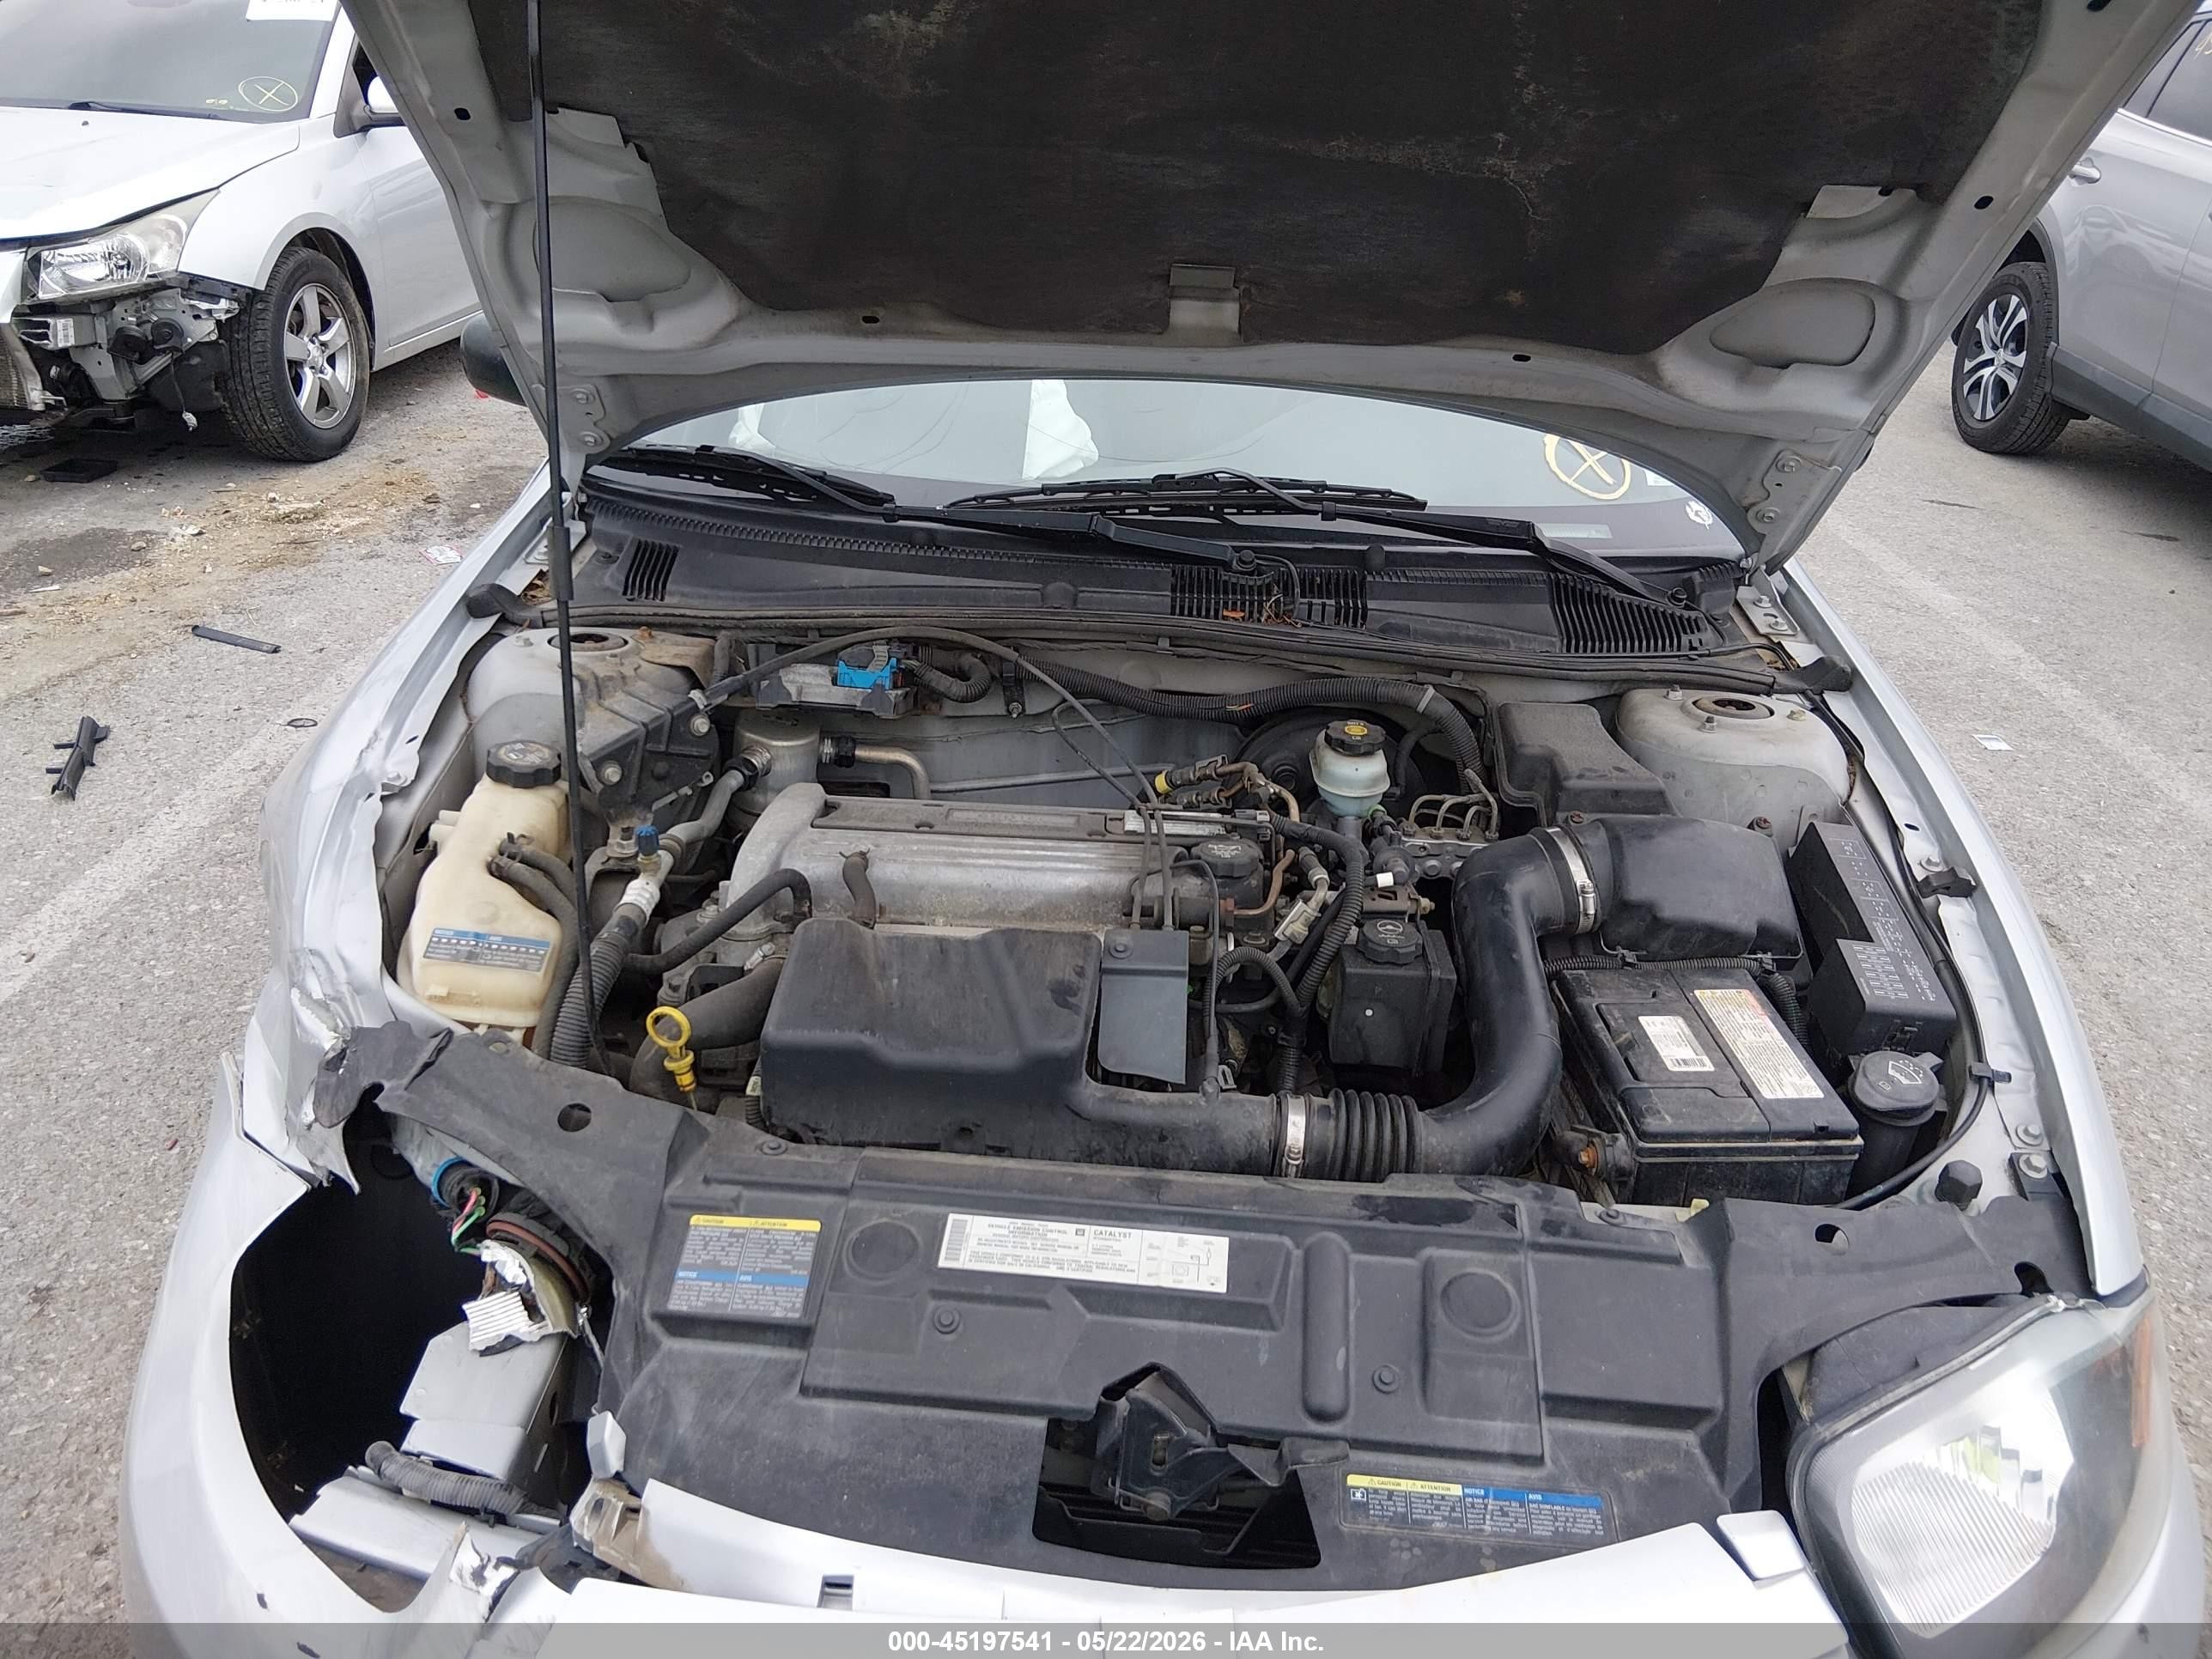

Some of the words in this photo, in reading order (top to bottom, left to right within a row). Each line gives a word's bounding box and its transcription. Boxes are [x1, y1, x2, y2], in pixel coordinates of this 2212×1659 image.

[1093, 1229, 1133, 1239] CATALYST
[1419, 1484, 1451, 1492] ATTENTION
[1464, 1487, 1485, 1496] NOTICE
[1528, 1492, 1543, 1501] AVIS
